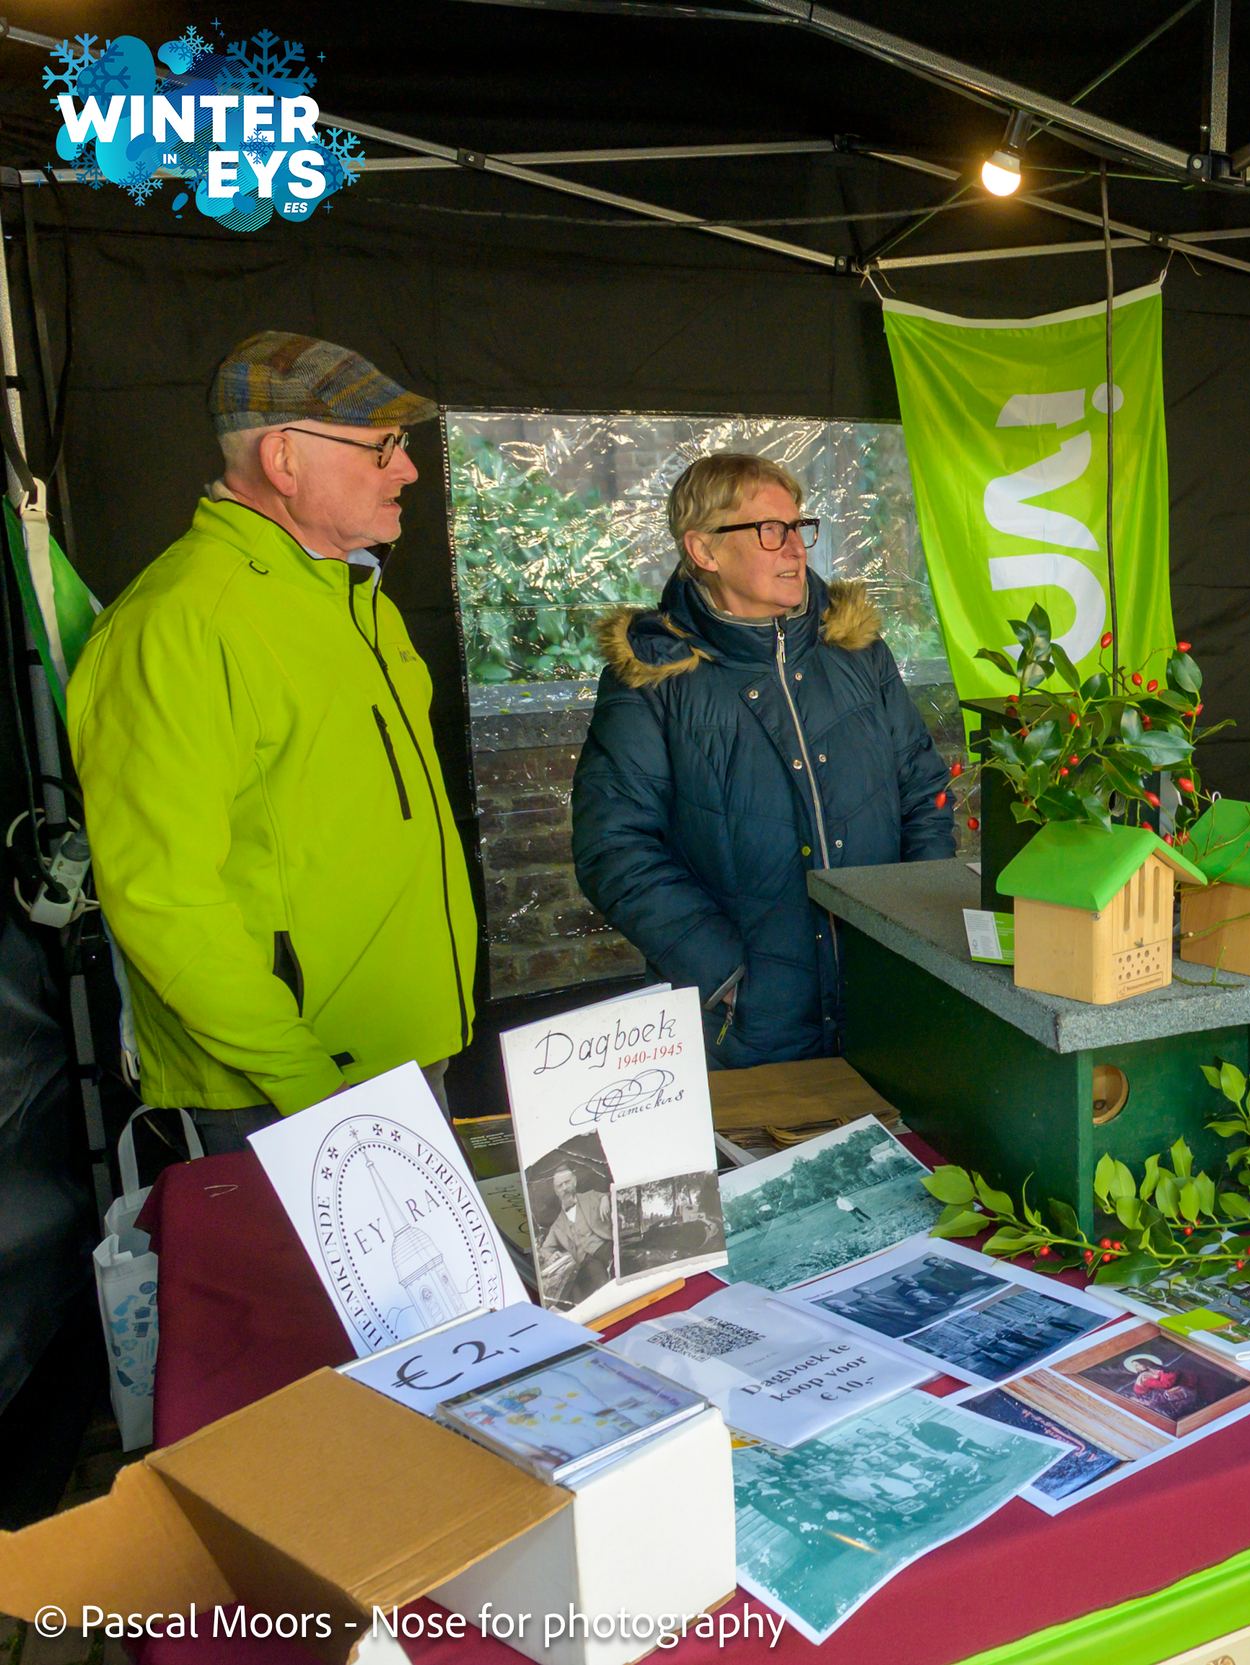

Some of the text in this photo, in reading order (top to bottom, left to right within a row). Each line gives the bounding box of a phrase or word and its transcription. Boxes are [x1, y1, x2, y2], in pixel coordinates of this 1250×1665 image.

[533, 1009, 677, 1075] Dagboek
[617, 1042, 683, 1070] 1940-1945
[354, 1189, 441, 1256] EY RA
[416, 1142, 494, 1266] VERENIGING
[317, 1195, 384, 1348] HEEMKUNDE
[740, 1353, 831, 1396] Dagboek
[829, 1343, 851, 1356] te
[769, 1356, 868, 1403] koop voor
